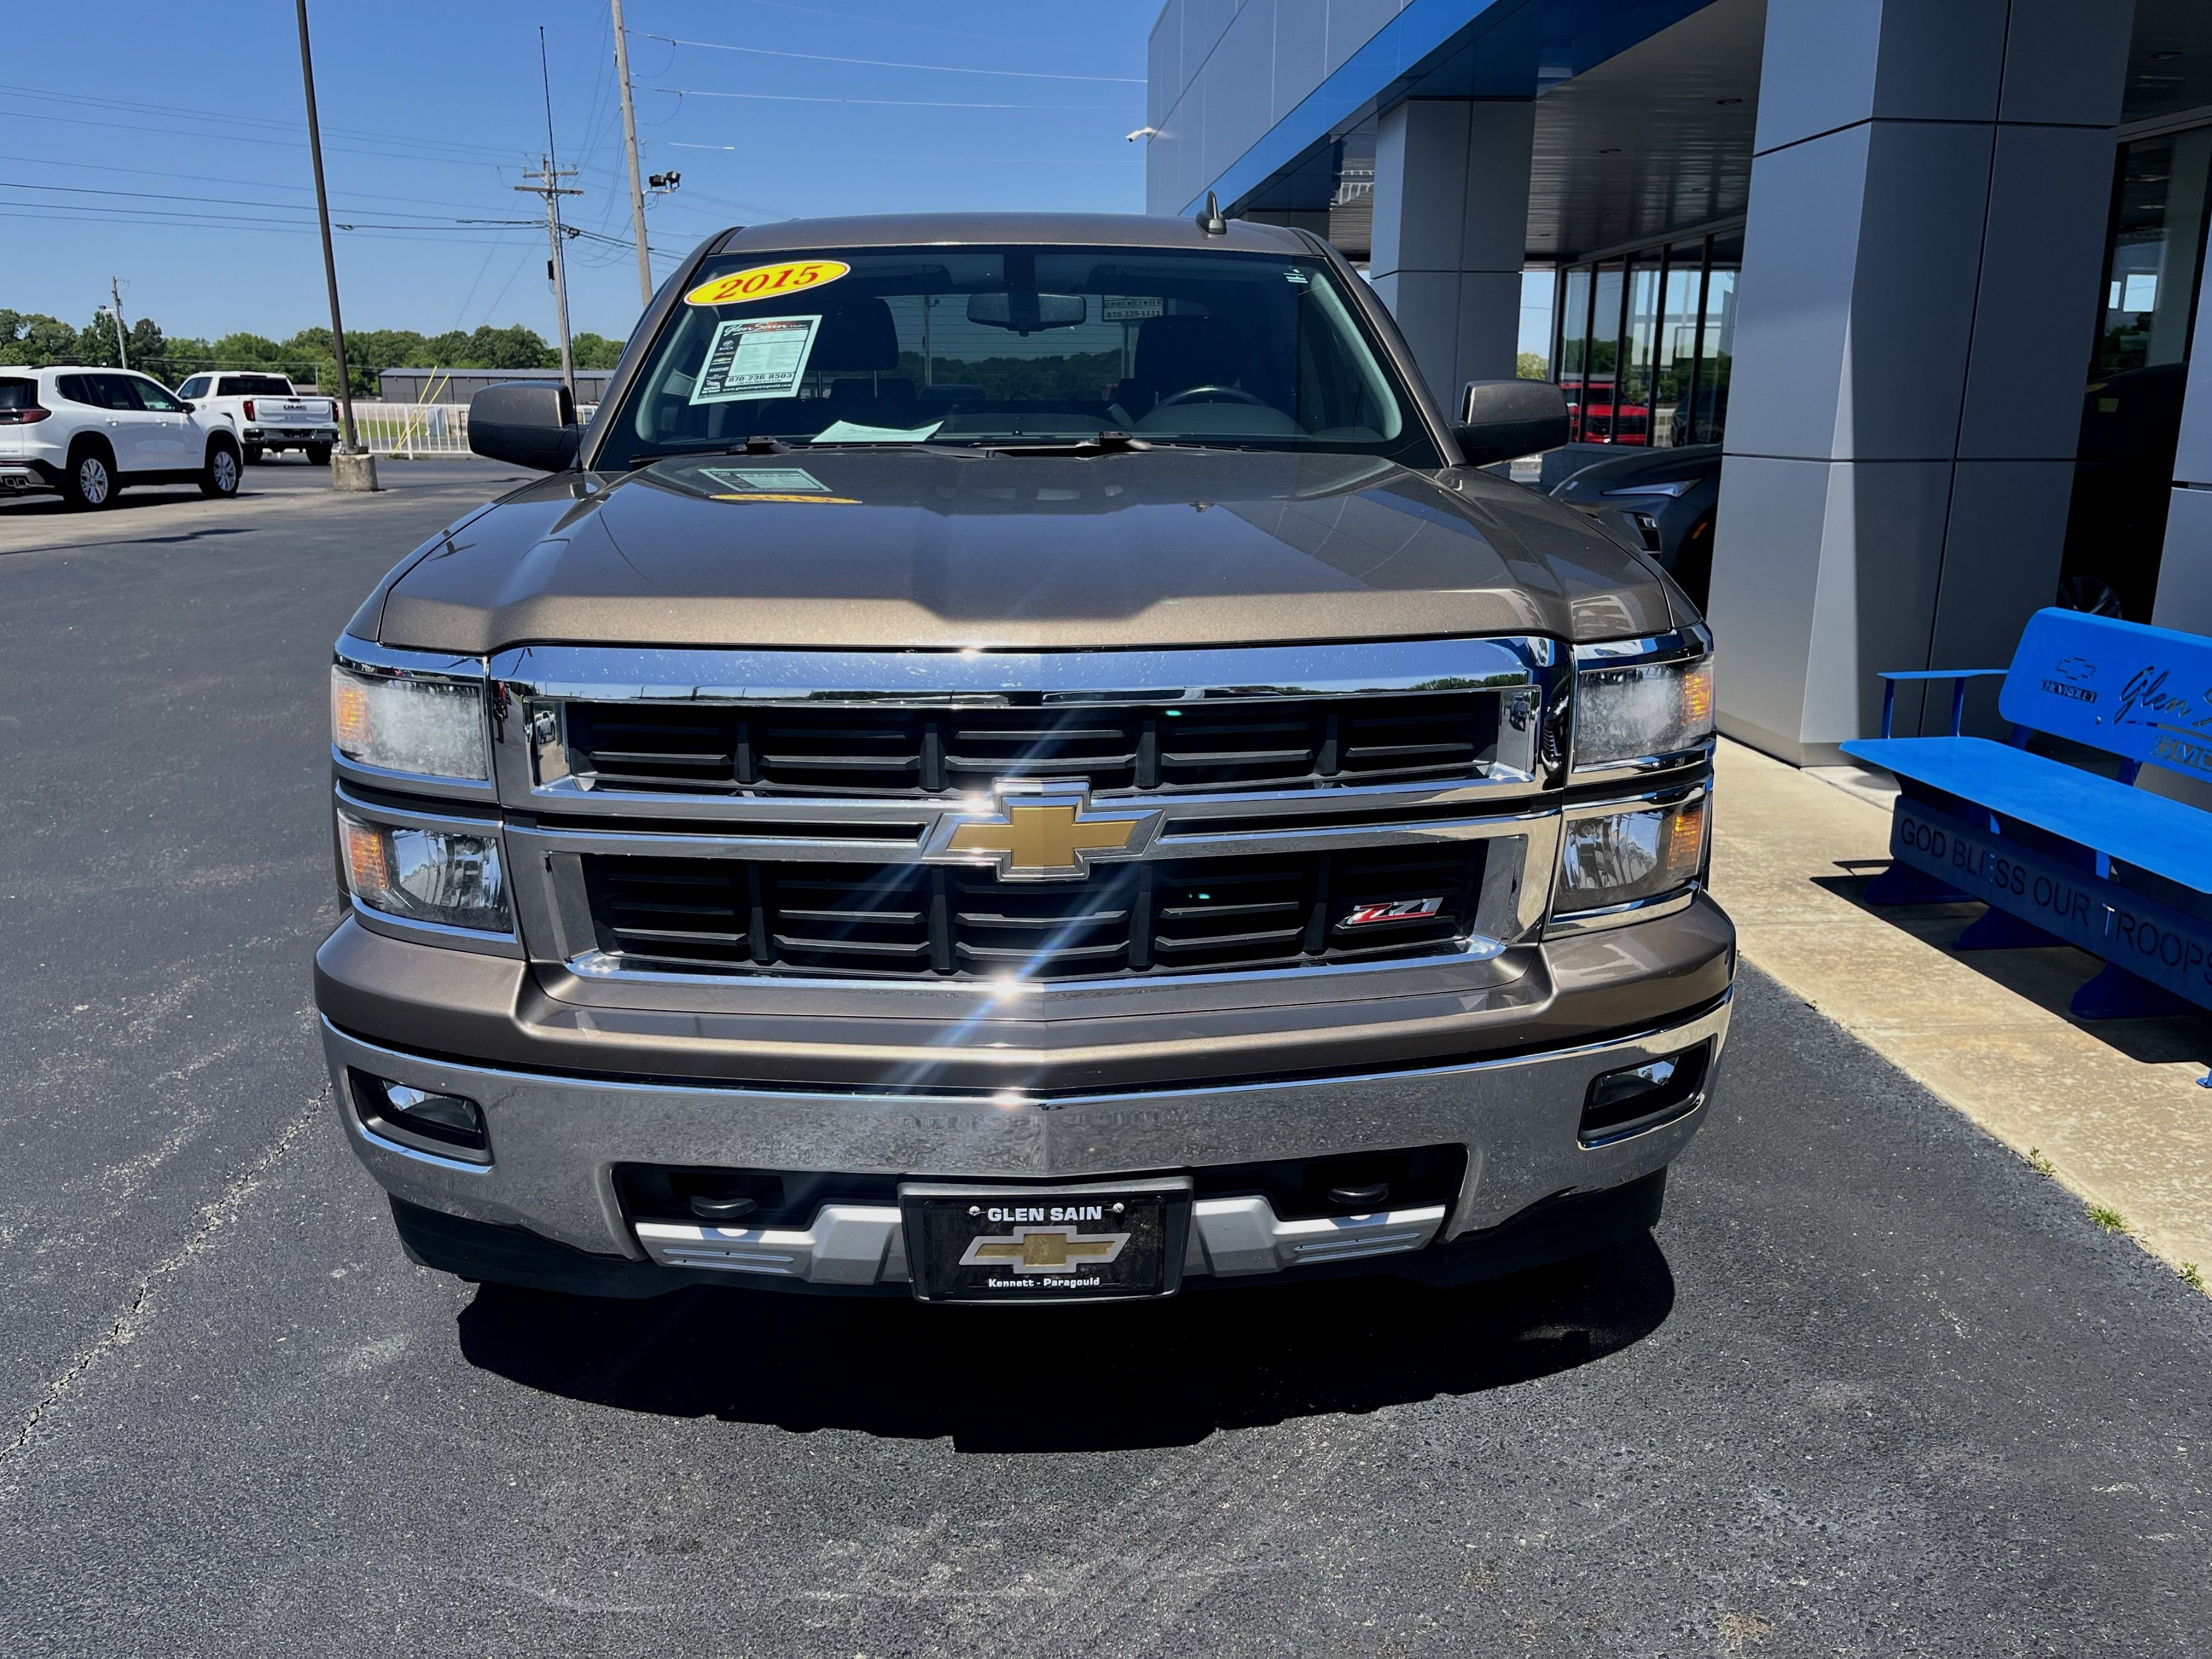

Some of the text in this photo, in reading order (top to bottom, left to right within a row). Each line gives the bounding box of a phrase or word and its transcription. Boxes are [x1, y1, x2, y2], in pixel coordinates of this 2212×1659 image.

[712, 265, 825, 301] 2015
[723, 323, 755, 337] Glen
[754, 322, 789, 333] Sain
[2112, 666, 2193, 725] Glen
[1901, 818, 1946, 859] GOD
[1951, 839, 2027, 896] BLESS
[2033, 876, 2091, 926] OUR
[1346, 897, 1443, 925] Z71
[988, 1206, 1102, 1222] GLEN SAIN
[988, 1278, 1034, 1288] Kennett
[1043, 1277, 1100, 1289] Paragould
